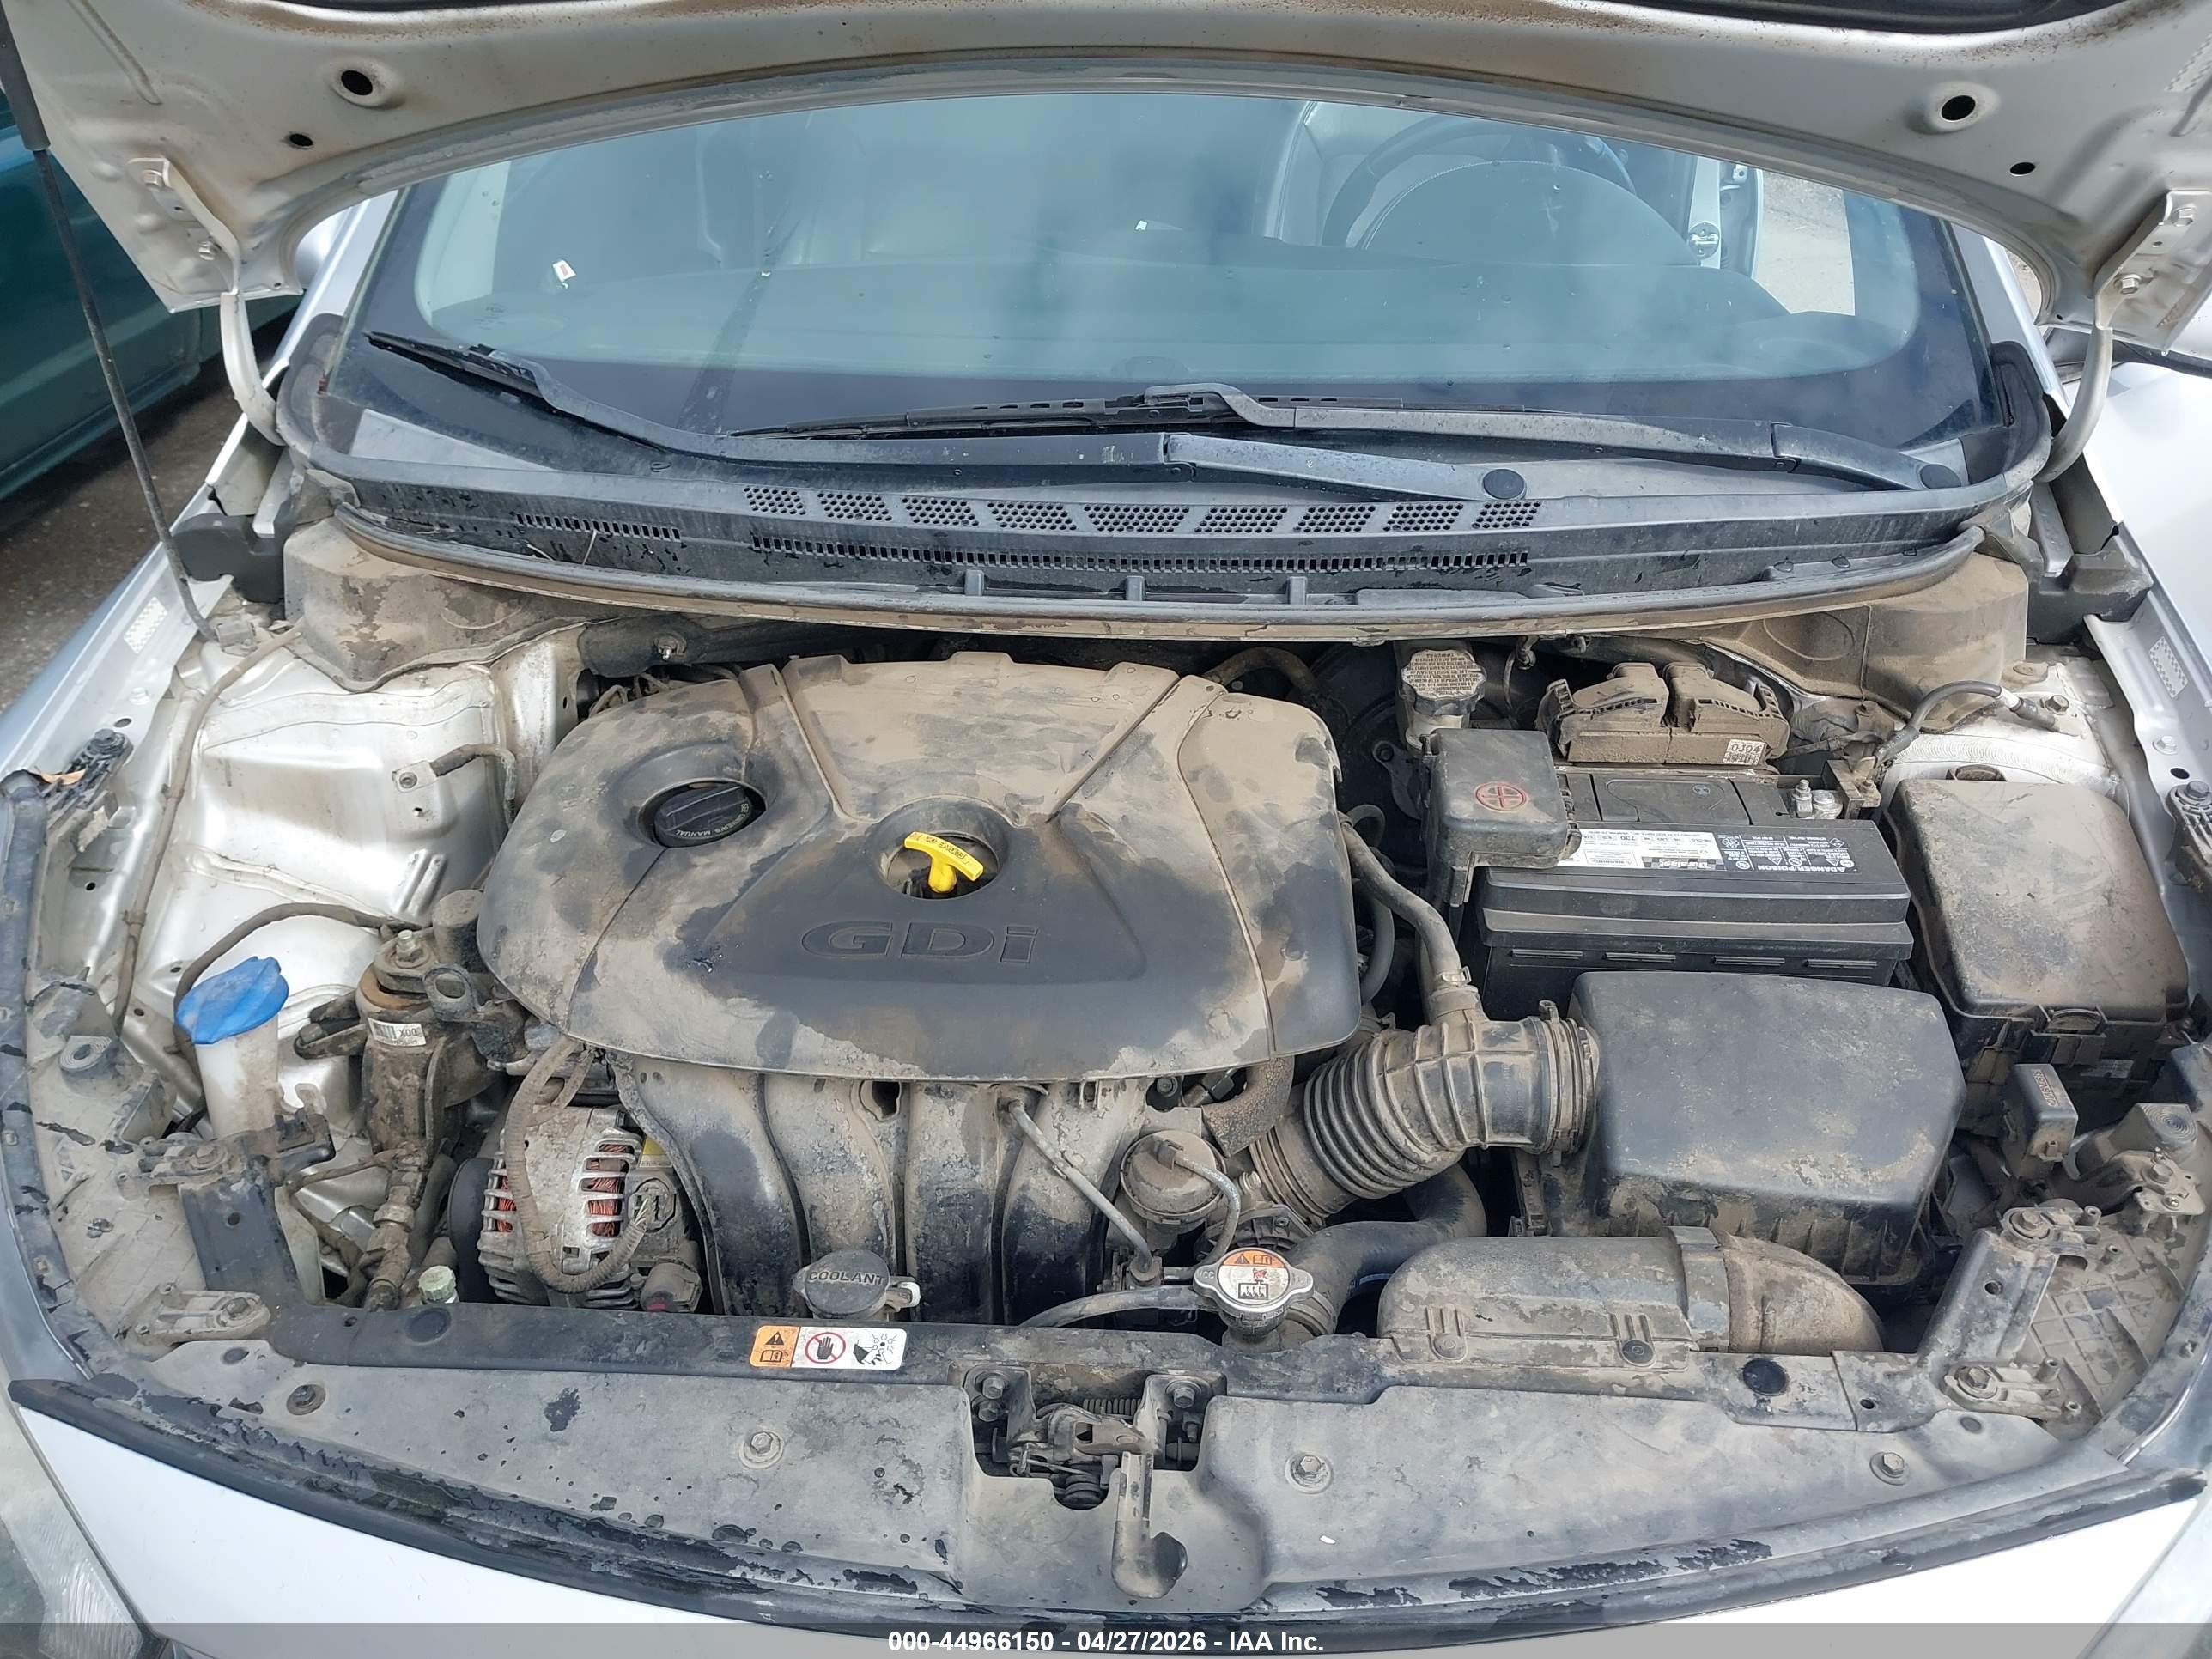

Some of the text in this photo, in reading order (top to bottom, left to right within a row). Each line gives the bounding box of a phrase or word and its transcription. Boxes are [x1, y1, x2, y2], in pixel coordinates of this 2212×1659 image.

[1659, 860, 1711, 869] Duralast
[1757, 864, 1837, 873] DANGER/POISON
[800, 920, 1040, 963] GDi
[809, 1271, 885, 1285] COOLANT
